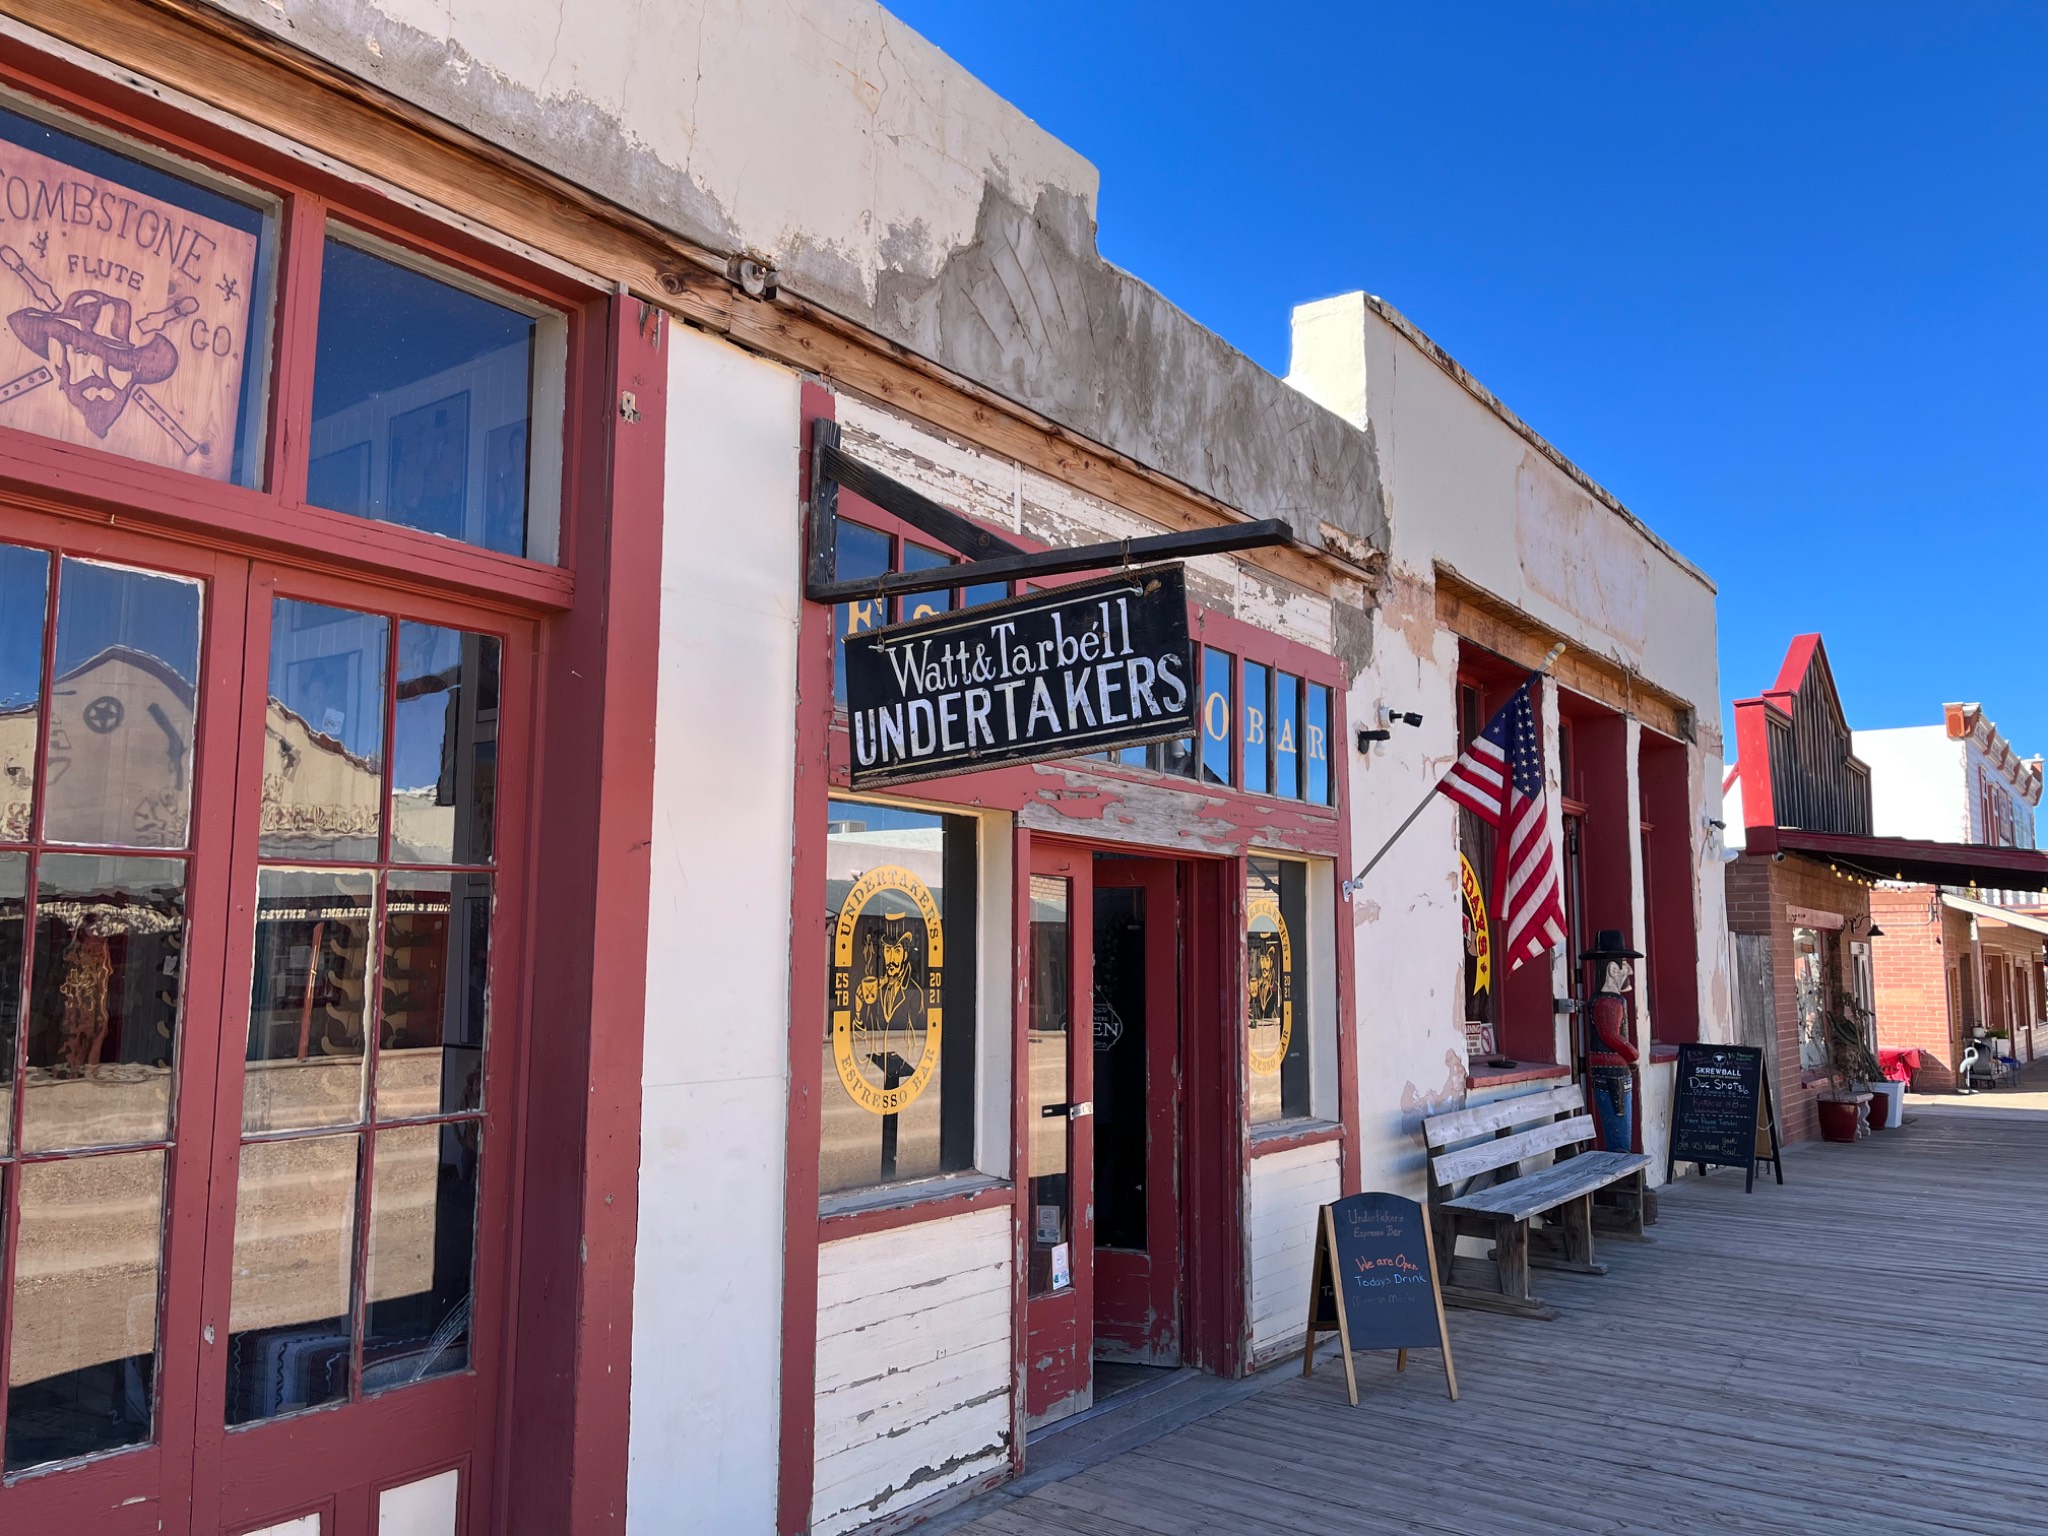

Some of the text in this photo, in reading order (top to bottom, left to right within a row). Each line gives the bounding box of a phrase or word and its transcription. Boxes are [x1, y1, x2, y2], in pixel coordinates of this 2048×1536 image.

[0, 169, 216, 282] OMBSTONE
[67, 254, 144, 291] FLUTE
[854, 652, 1187, 766] UNDERTAKERS
[1247, 706, 1326, 761] BAR
[840, 868, 939, 939] UNDERTAKER'S
[840, 1047, 935, 1109] ESPRESSO BAR
[1695, 1067, 1742, 1076] SKREWBALL
[1355, 1253, 1419, 1272] We are Open
[1393, 1273, 1427, 1285] Drink
